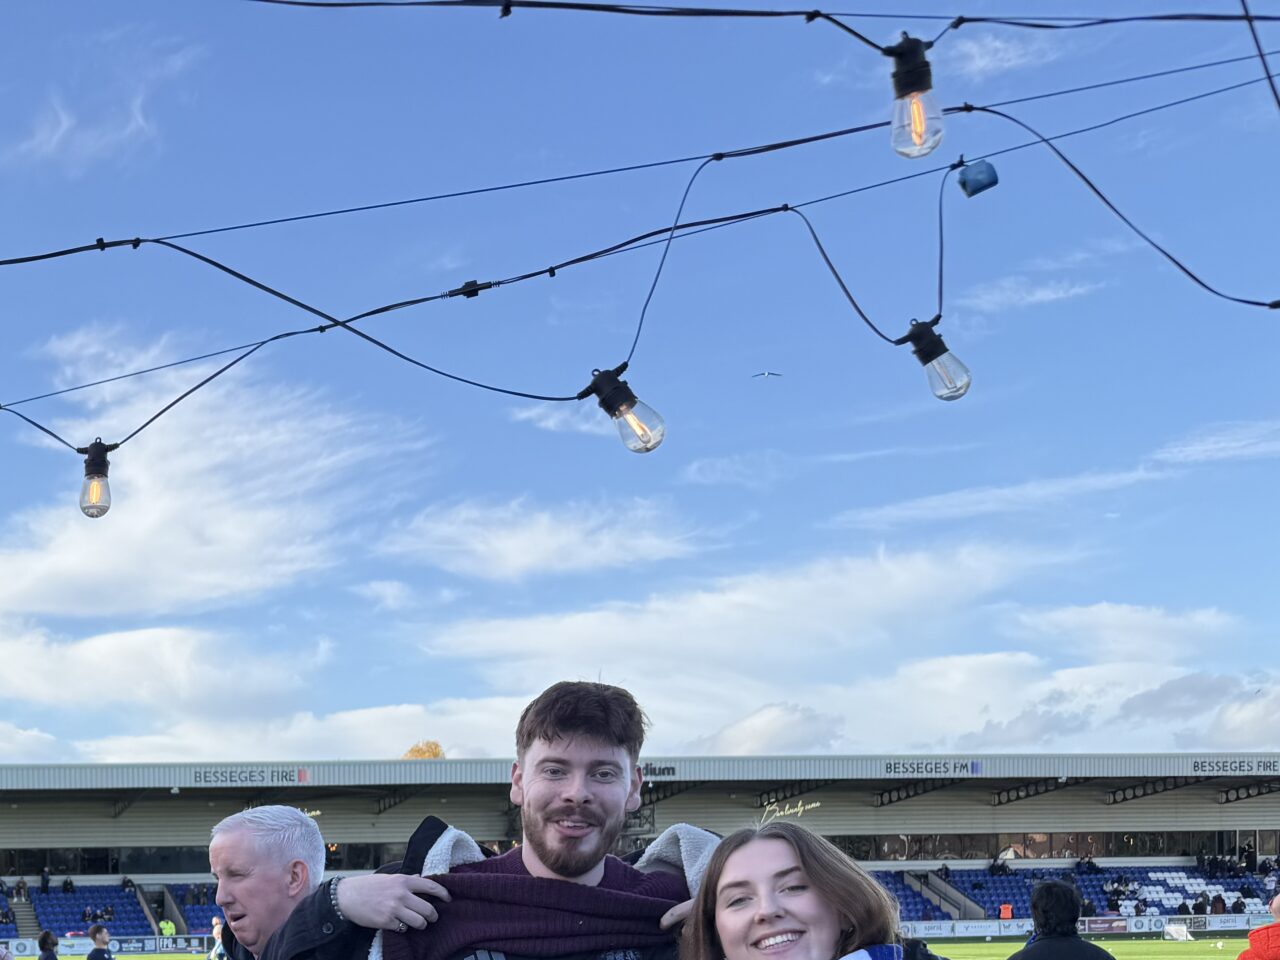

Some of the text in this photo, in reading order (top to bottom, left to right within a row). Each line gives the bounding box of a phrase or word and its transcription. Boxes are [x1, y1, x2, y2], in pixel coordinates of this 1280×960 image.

[641, 763, 676, 776] dium
[885, 762, 969, 774] BESSEGES FM
[1193, 760, 1279, 772] BESSEGES FIRE
[194, 770, 295, 783] BESSEGES FIRE
